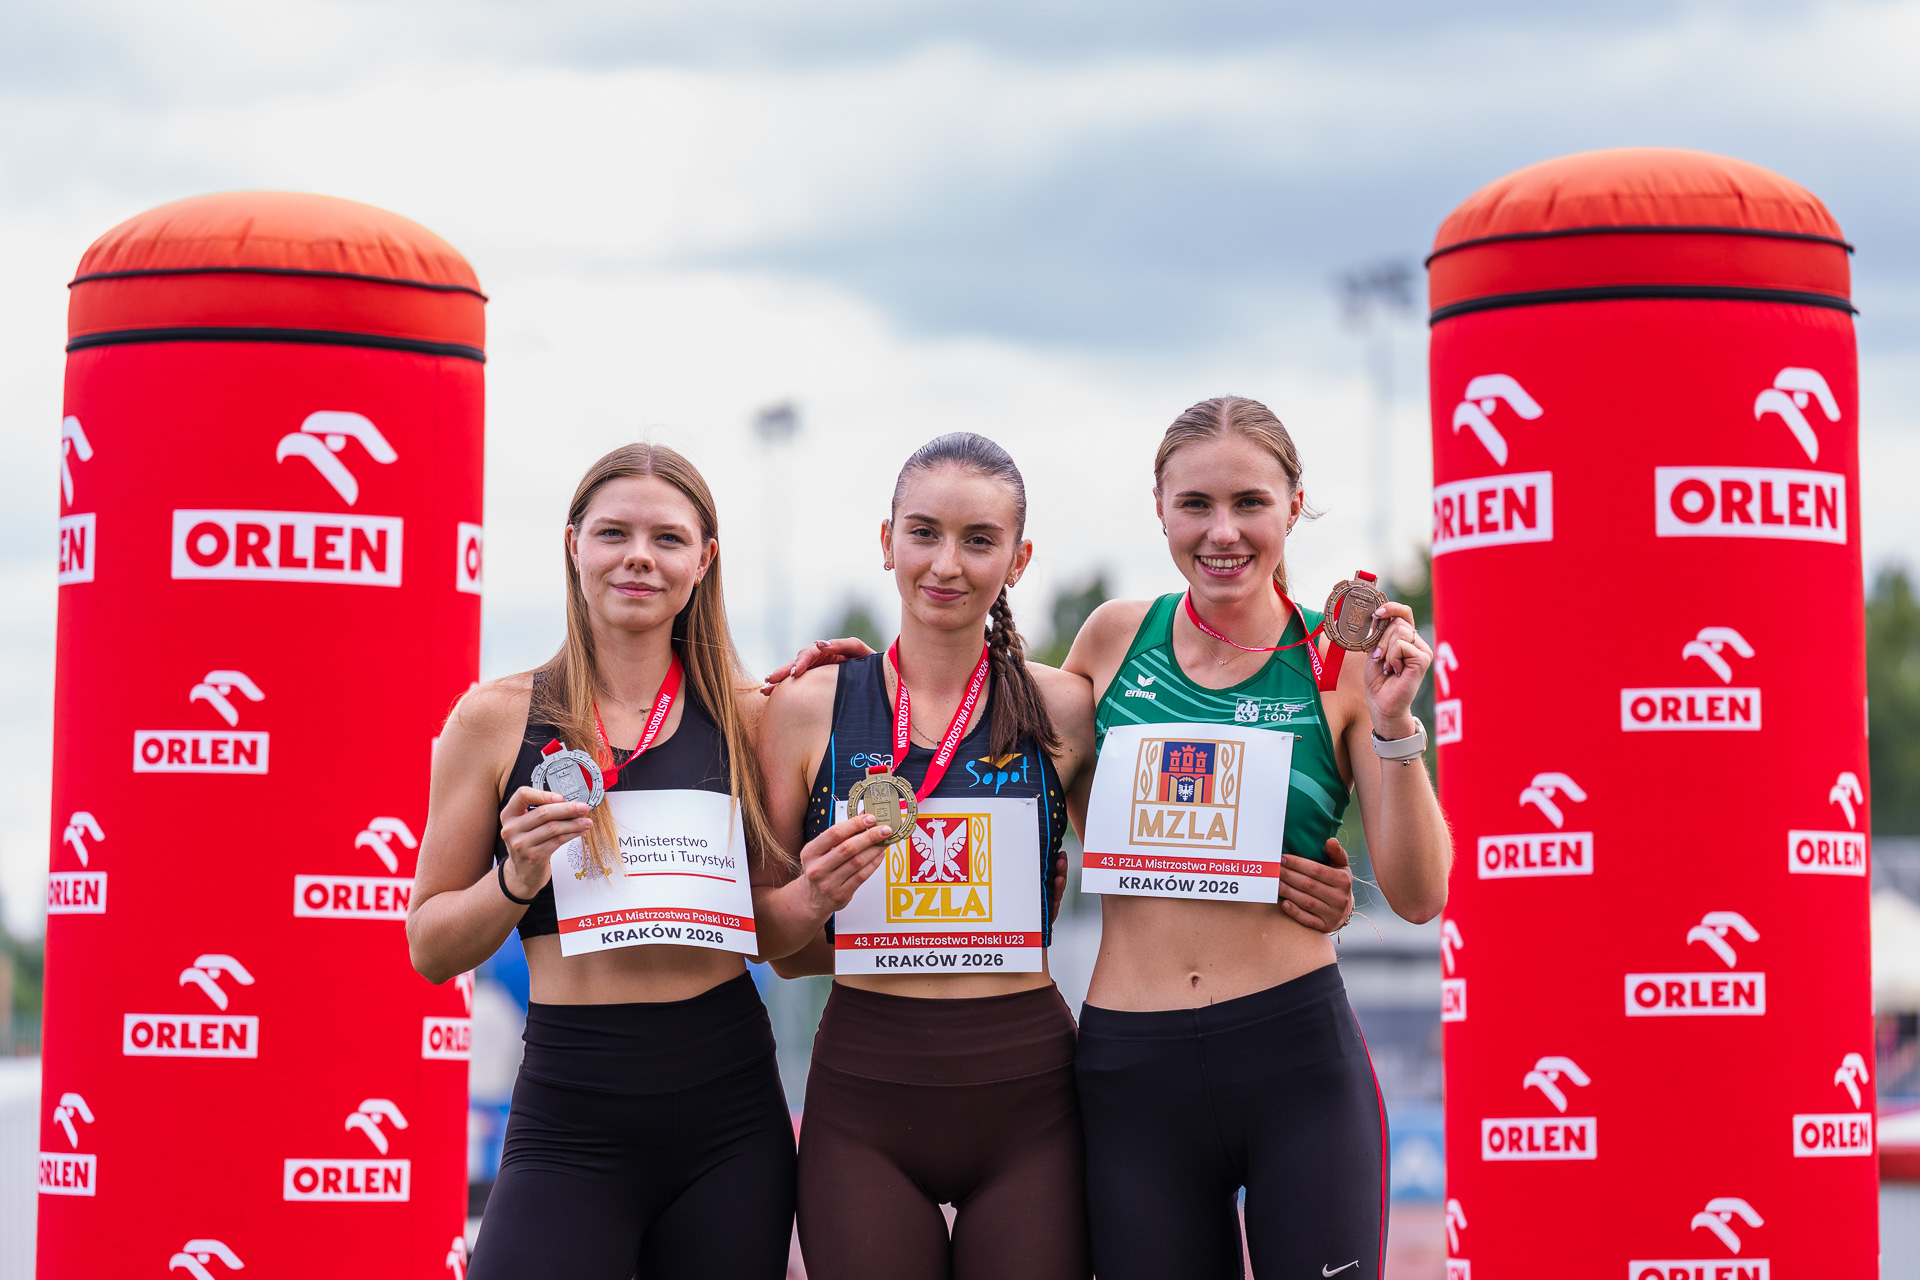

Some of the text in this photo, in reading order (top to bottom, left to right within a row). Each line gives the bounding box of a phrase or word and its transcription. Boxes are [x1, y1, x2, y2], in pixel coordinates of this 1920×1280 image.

[1669, 478, 1838, 531] ORLEN
[185, 521, 388, 573] ORLEN
[1124, 688, 1157, 701] erima
[641, 692, 671, 748] MISTRZOSTWA
[897, 685, 909, 749] MISTRZOSTWA
[936, 658, 989, 767] MISTRZOSTWA POLSKI 2026
[1630, 696, 1752, 724] ORLEN
[141, 737, 258, 766] ORLEN
[965, 756, 1030, 795] Sopot
[1137, 808, 1229, 842] MZLA
[618, 835, 708, 848] Ministerstwo
[1484, 840, 1583, 871] ORLEN
[1796, 839, 1863, 866] ORLEN
[621, 850, 735, 869] Sportu i Turystyki
[1100, 856, 1263, 874] 43. PZLA Mistrzostwa Polski U23
[303, 882, 411, 912] ORLEN
[1119, 874, 1239, 895] KRAKÓW 2026
[891, 887, 987, 917] PZLA
[577, 910, 740, 928] 43. PZLA Mistrzostwa Polski U23
[601, 923, 724, 944] KRAKÓW 2026
[854, 934, 1025, 947] 43. PZLA Mistrzostwa Polski U23
[875, 950, 1004, 968] KRAKÓW 2026
[1634, 980, 1756, 1009] ORLEN
[131, 1021, 248, 1050] ORLEN
[430, 1025, 470, 1052] ORLE
[1488, 1125, 1587, 1154] ORLEN
[1801, 1122, 1869, 1150] ORLEN
[292, 1166, 403, 1194] ORLEN
